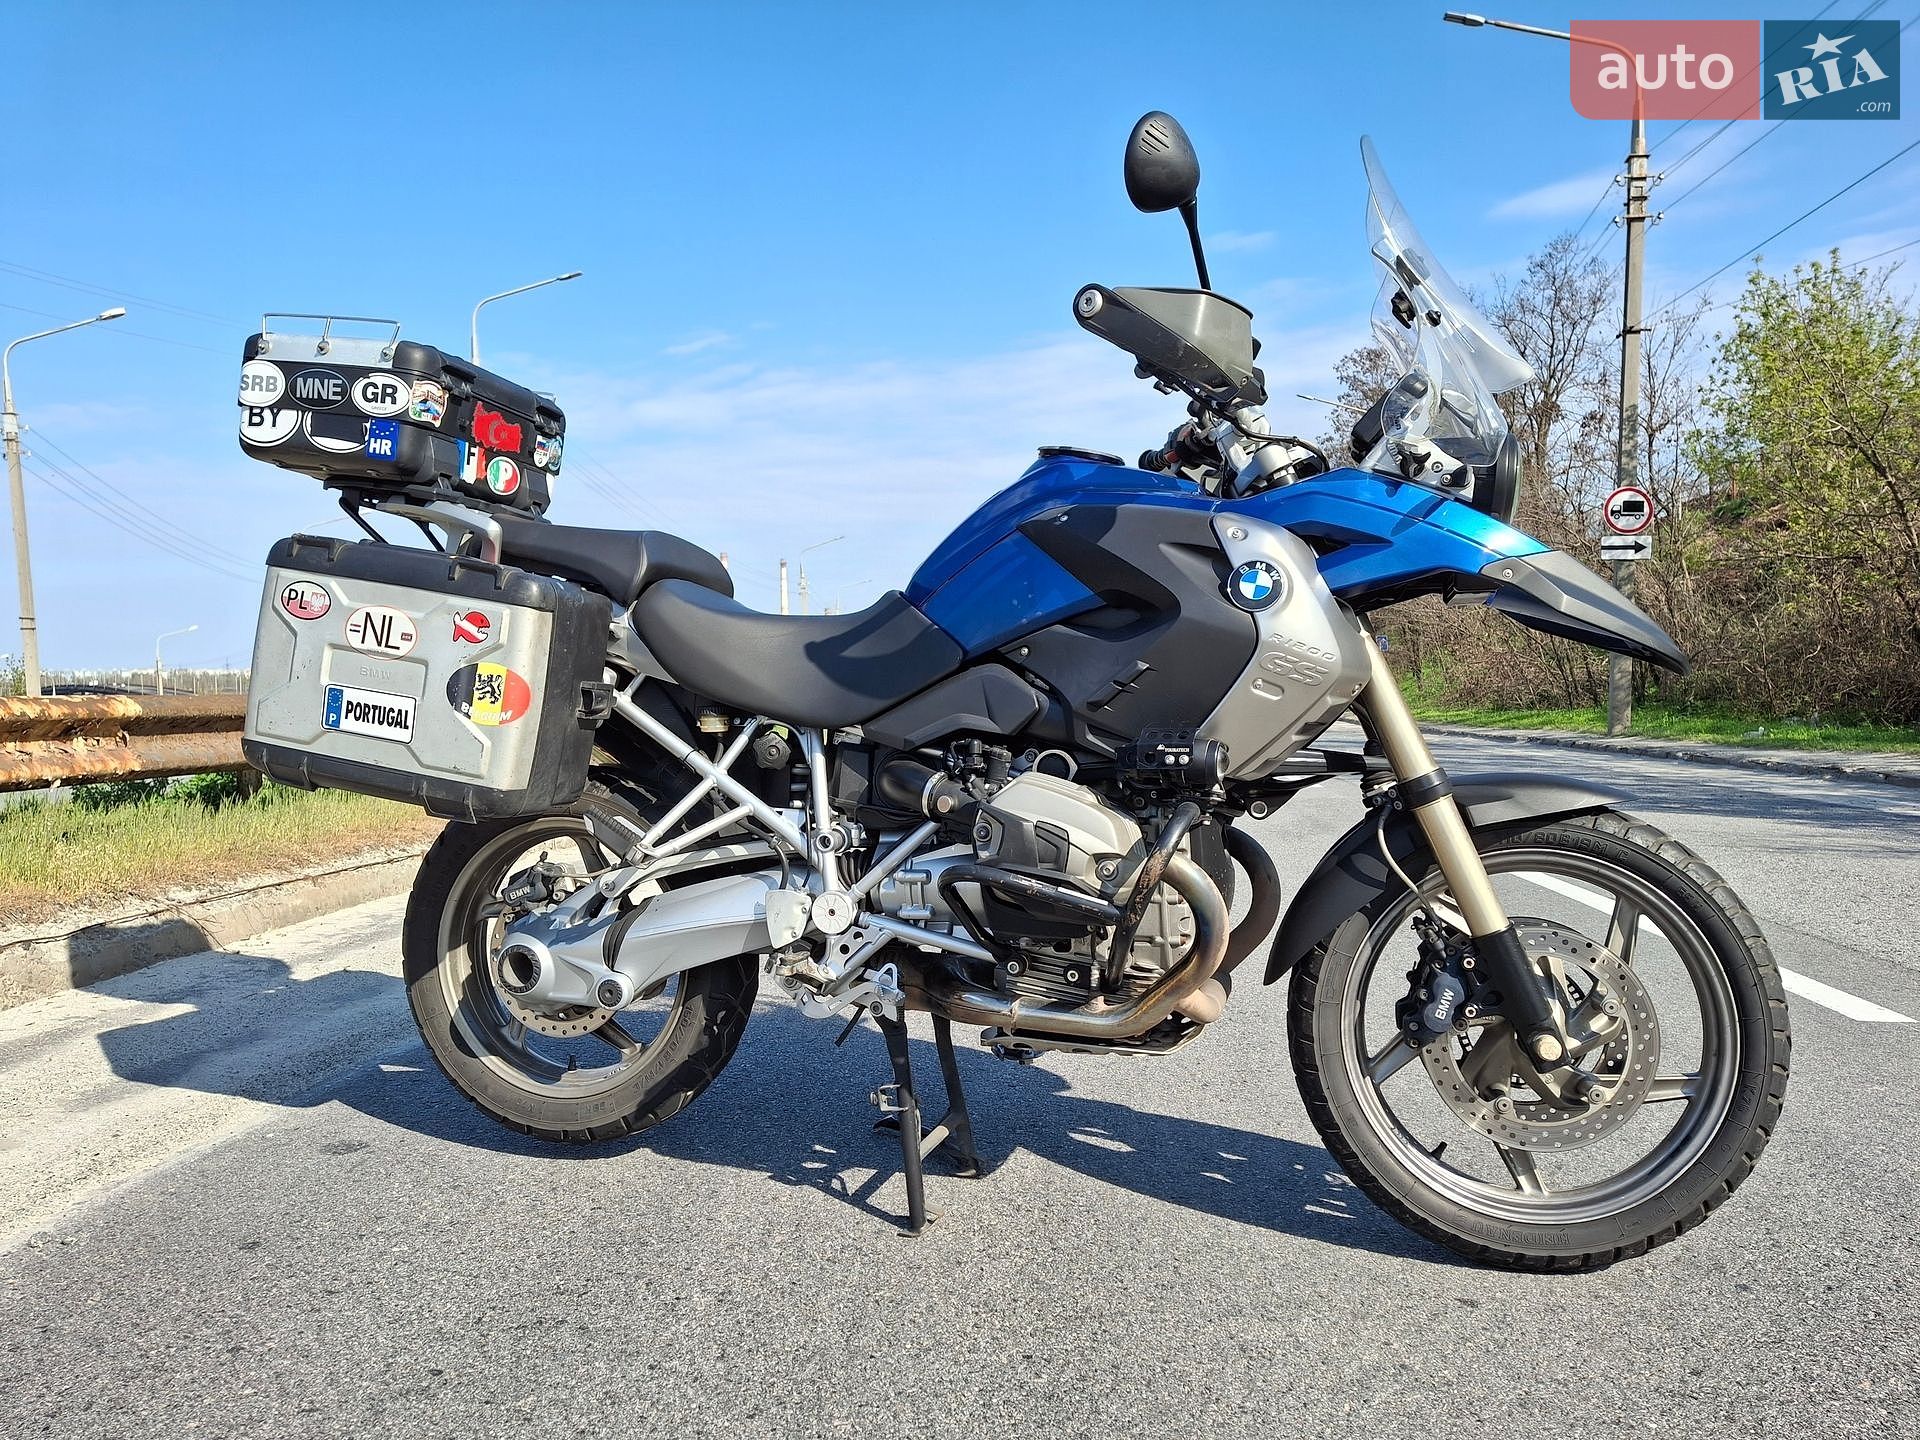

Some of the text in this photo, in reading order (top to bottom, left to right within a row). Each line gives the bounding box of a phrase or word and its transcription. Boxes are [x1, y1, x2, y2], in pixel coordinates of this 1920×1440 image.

[240, 373, 278, 393] SRB
[296, 377, 343, 401] MNE
[362, 382, 398, 405] GR
[248, 407, 280, 428] BY
[369, 438, 392, 456] HR
[1239, 562, 1281, 581] BMW
[287, 588, 308, 611] PL
[361, 611, 401, 651] NL
[360, 665, 392, 681] BMW
[1260, 651, 1329, 687] GS
[329, 700, 410, 730] P PORTUGAL
[509, 885, 531, 900] BMW
[1435, 988, 1455, 1020] BMW
